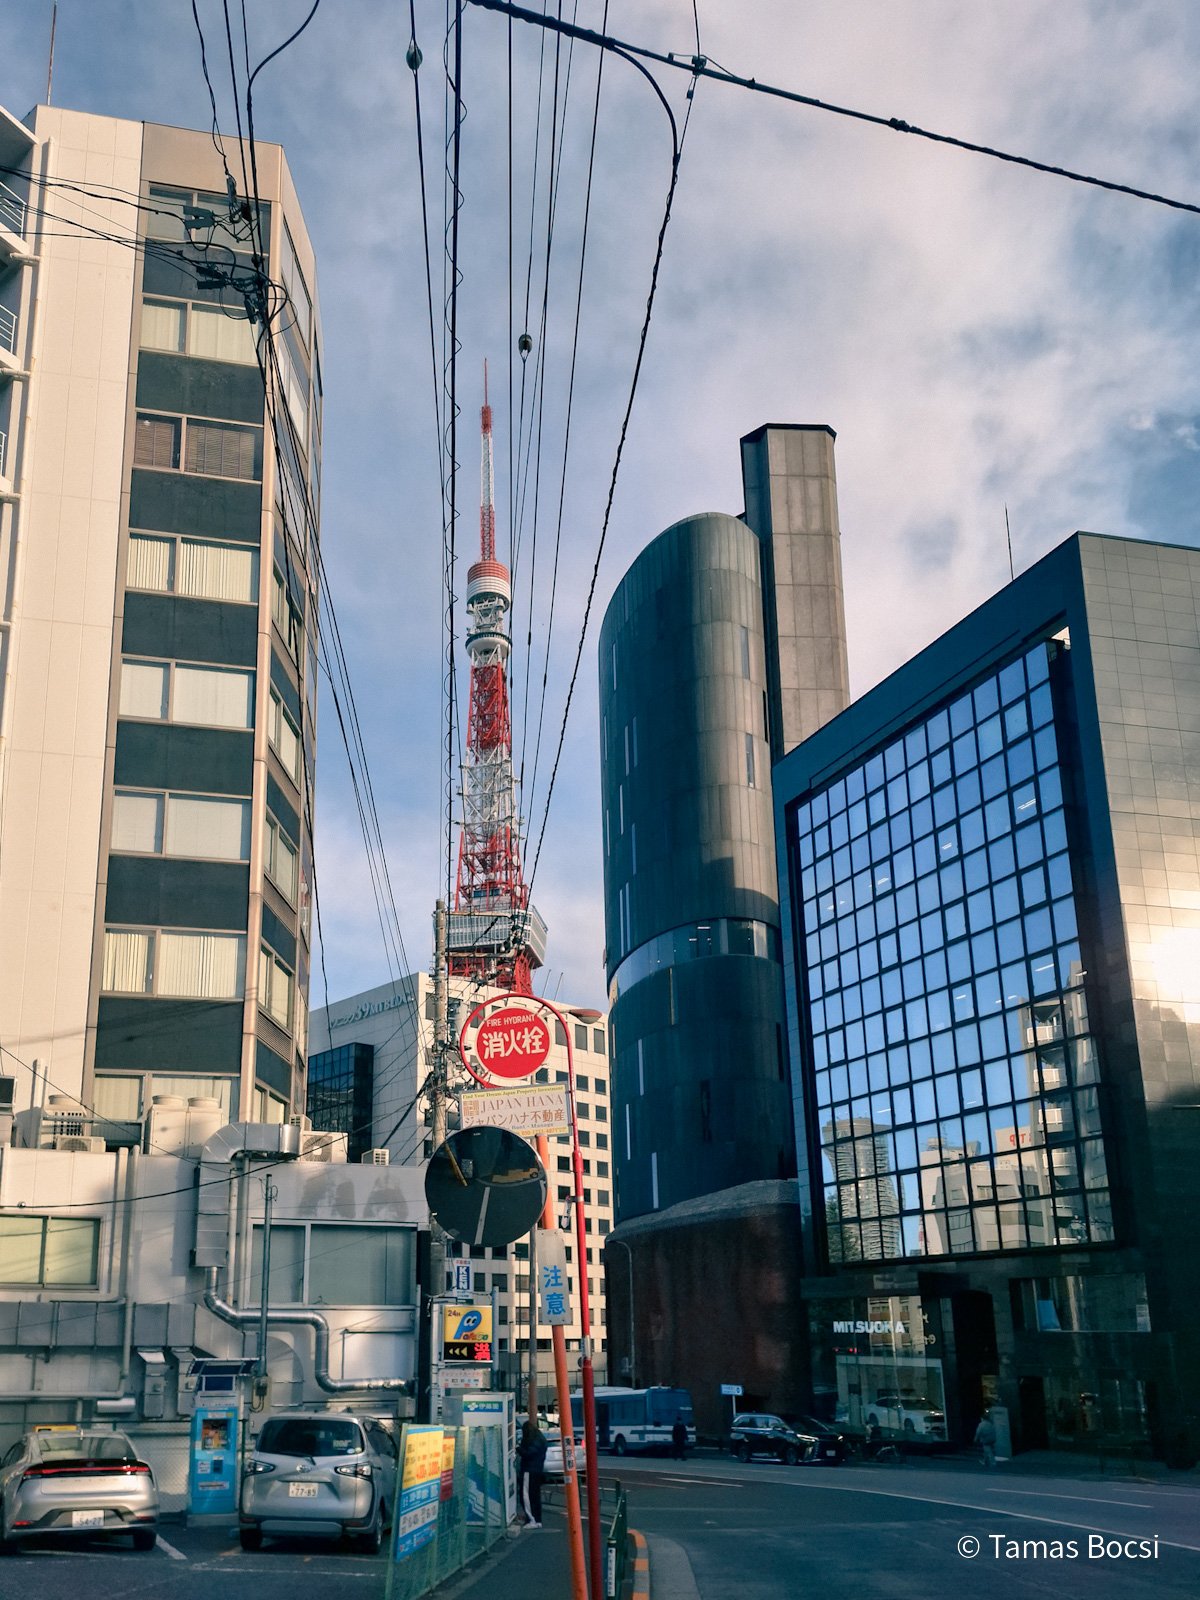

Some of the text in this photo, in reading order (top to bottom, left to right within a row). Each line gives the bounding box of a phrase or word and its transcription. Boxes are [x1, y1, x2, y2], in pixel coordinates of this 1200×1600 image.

[486, 1014, 535, 1027] FIRE HYDRANT
[482, 1026, 545, 1059] 消火栓
[481, 1094, 564, 1113] JAPAN HANA
[459, 1266, 468, 1290] KEN
[543, 1265, 566, 1315] 注意
[833, 1321, 905, 1333] MITSUOKA
[474, 1343, 490, 1360] 満
